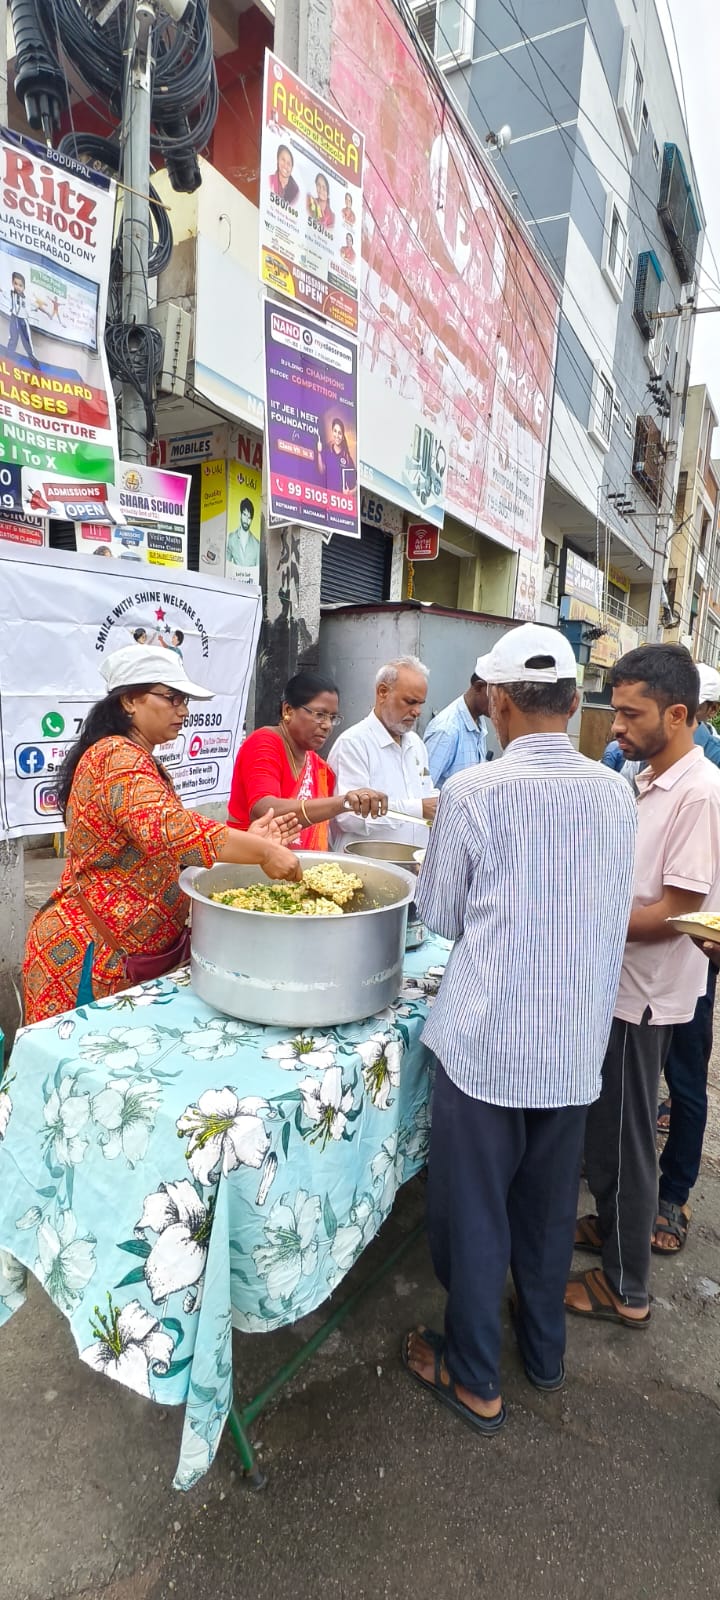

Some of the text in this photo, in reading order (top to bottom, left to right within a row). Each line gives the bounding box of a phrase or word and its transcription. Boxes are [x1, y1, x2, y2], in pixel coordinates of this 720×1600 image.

[46, 147, 91, 178] BODUPPAL
[3, 146, 97, 226] Ritz
[3, 188, 97, 248] SCHOOL
[10, 230, 72, 265] HYDERABAD.
[58, 238, 96, 264] COLONY
[292, 266, 328, 295] ADMISSIONS
[298, 280, 323, 304] OPEN
[273, 316, 300, 340] NANO
[14, 367, 92, 401] STANDARD
[291, 374, 337, 400] COMPETITION
[306, 367, 345, 391] CHAMPIONS
[270, 400, 280, 410] IIT
[282, 402, 295, 414] JEE
[300, 410, 319, 424] NEET
[271, 412, 320, 436] FOUNDATION
[18, 411, 96, 440] STRUCTURE
[4, 423, 80, 456] NURSERY
[170, 440, 210, 456] MOBILES
[22, 450, 40, 466] To
[46, 456, 57, 470] X
[48, 486, 100, 497] ADMISSIONS
[120, 492, 150, 510] SHARA
[151, 498, 184, 516] SCHOOL
[288, 482, 354, 511] 99 5105 5105
[66, 502, 105, 518] OPEN
[96, 592, 209, 658] SMILE WITH SHINE WELFARE SOCIETY
[198, 776, 216, 786] Society
